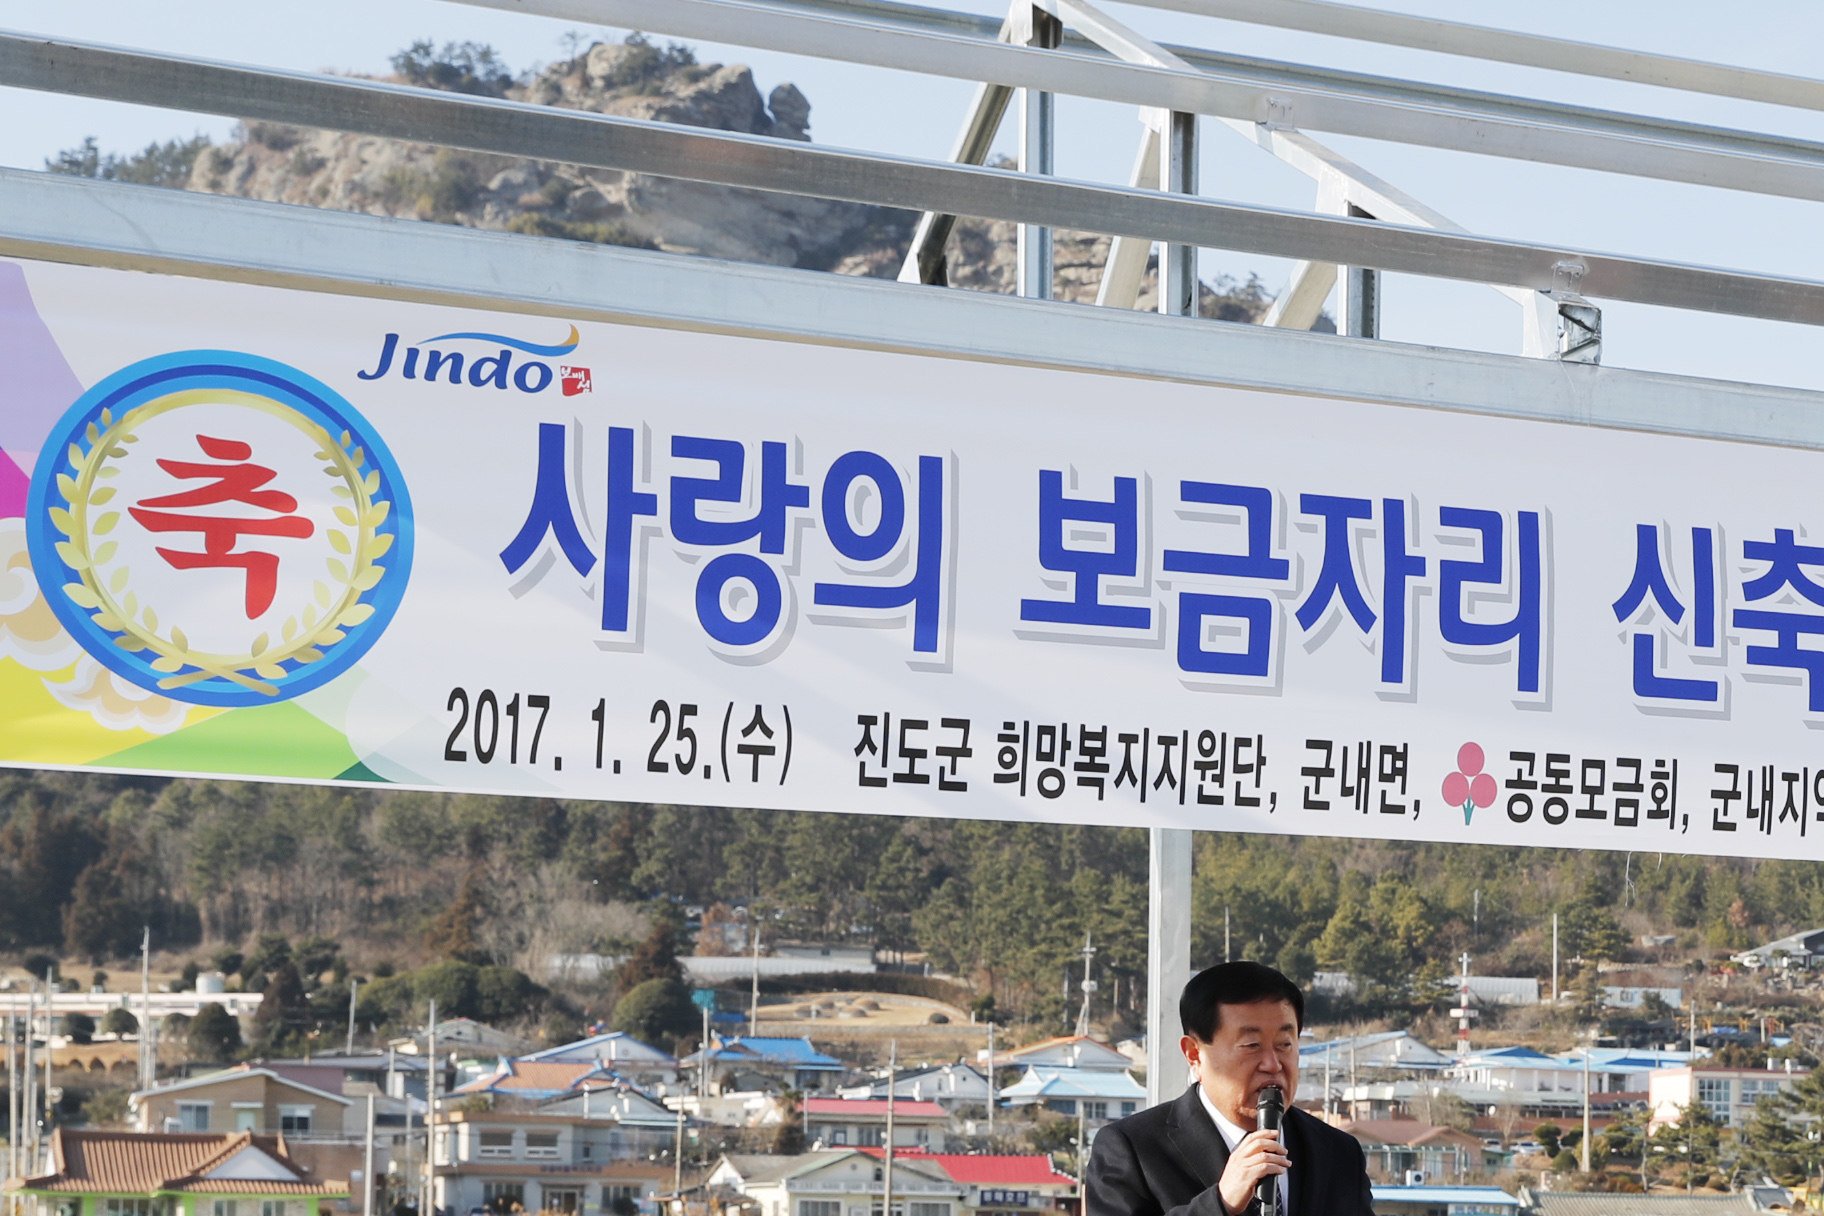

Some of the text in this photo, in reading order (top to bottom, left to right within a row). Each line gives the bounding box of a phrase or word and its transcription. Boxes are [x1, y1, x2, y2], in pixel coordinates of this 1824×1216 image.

[357, 333, 553, 393] Jindo
[128, 434, 314, 619] 축
[499, 424, 943, 652] 사랑의
[1021, 469, 1539, 691] 보금자리
[444, 687, 793, 787] 2017. 1. 25.(수)
[854, 712, 972, 792] 진도군
[993, 720, 1277, 813] 희망복지지원단,
[1301, 738, 1421, 822] 군내면,
[1505, 750, 1689, 835] 공동모금회,
